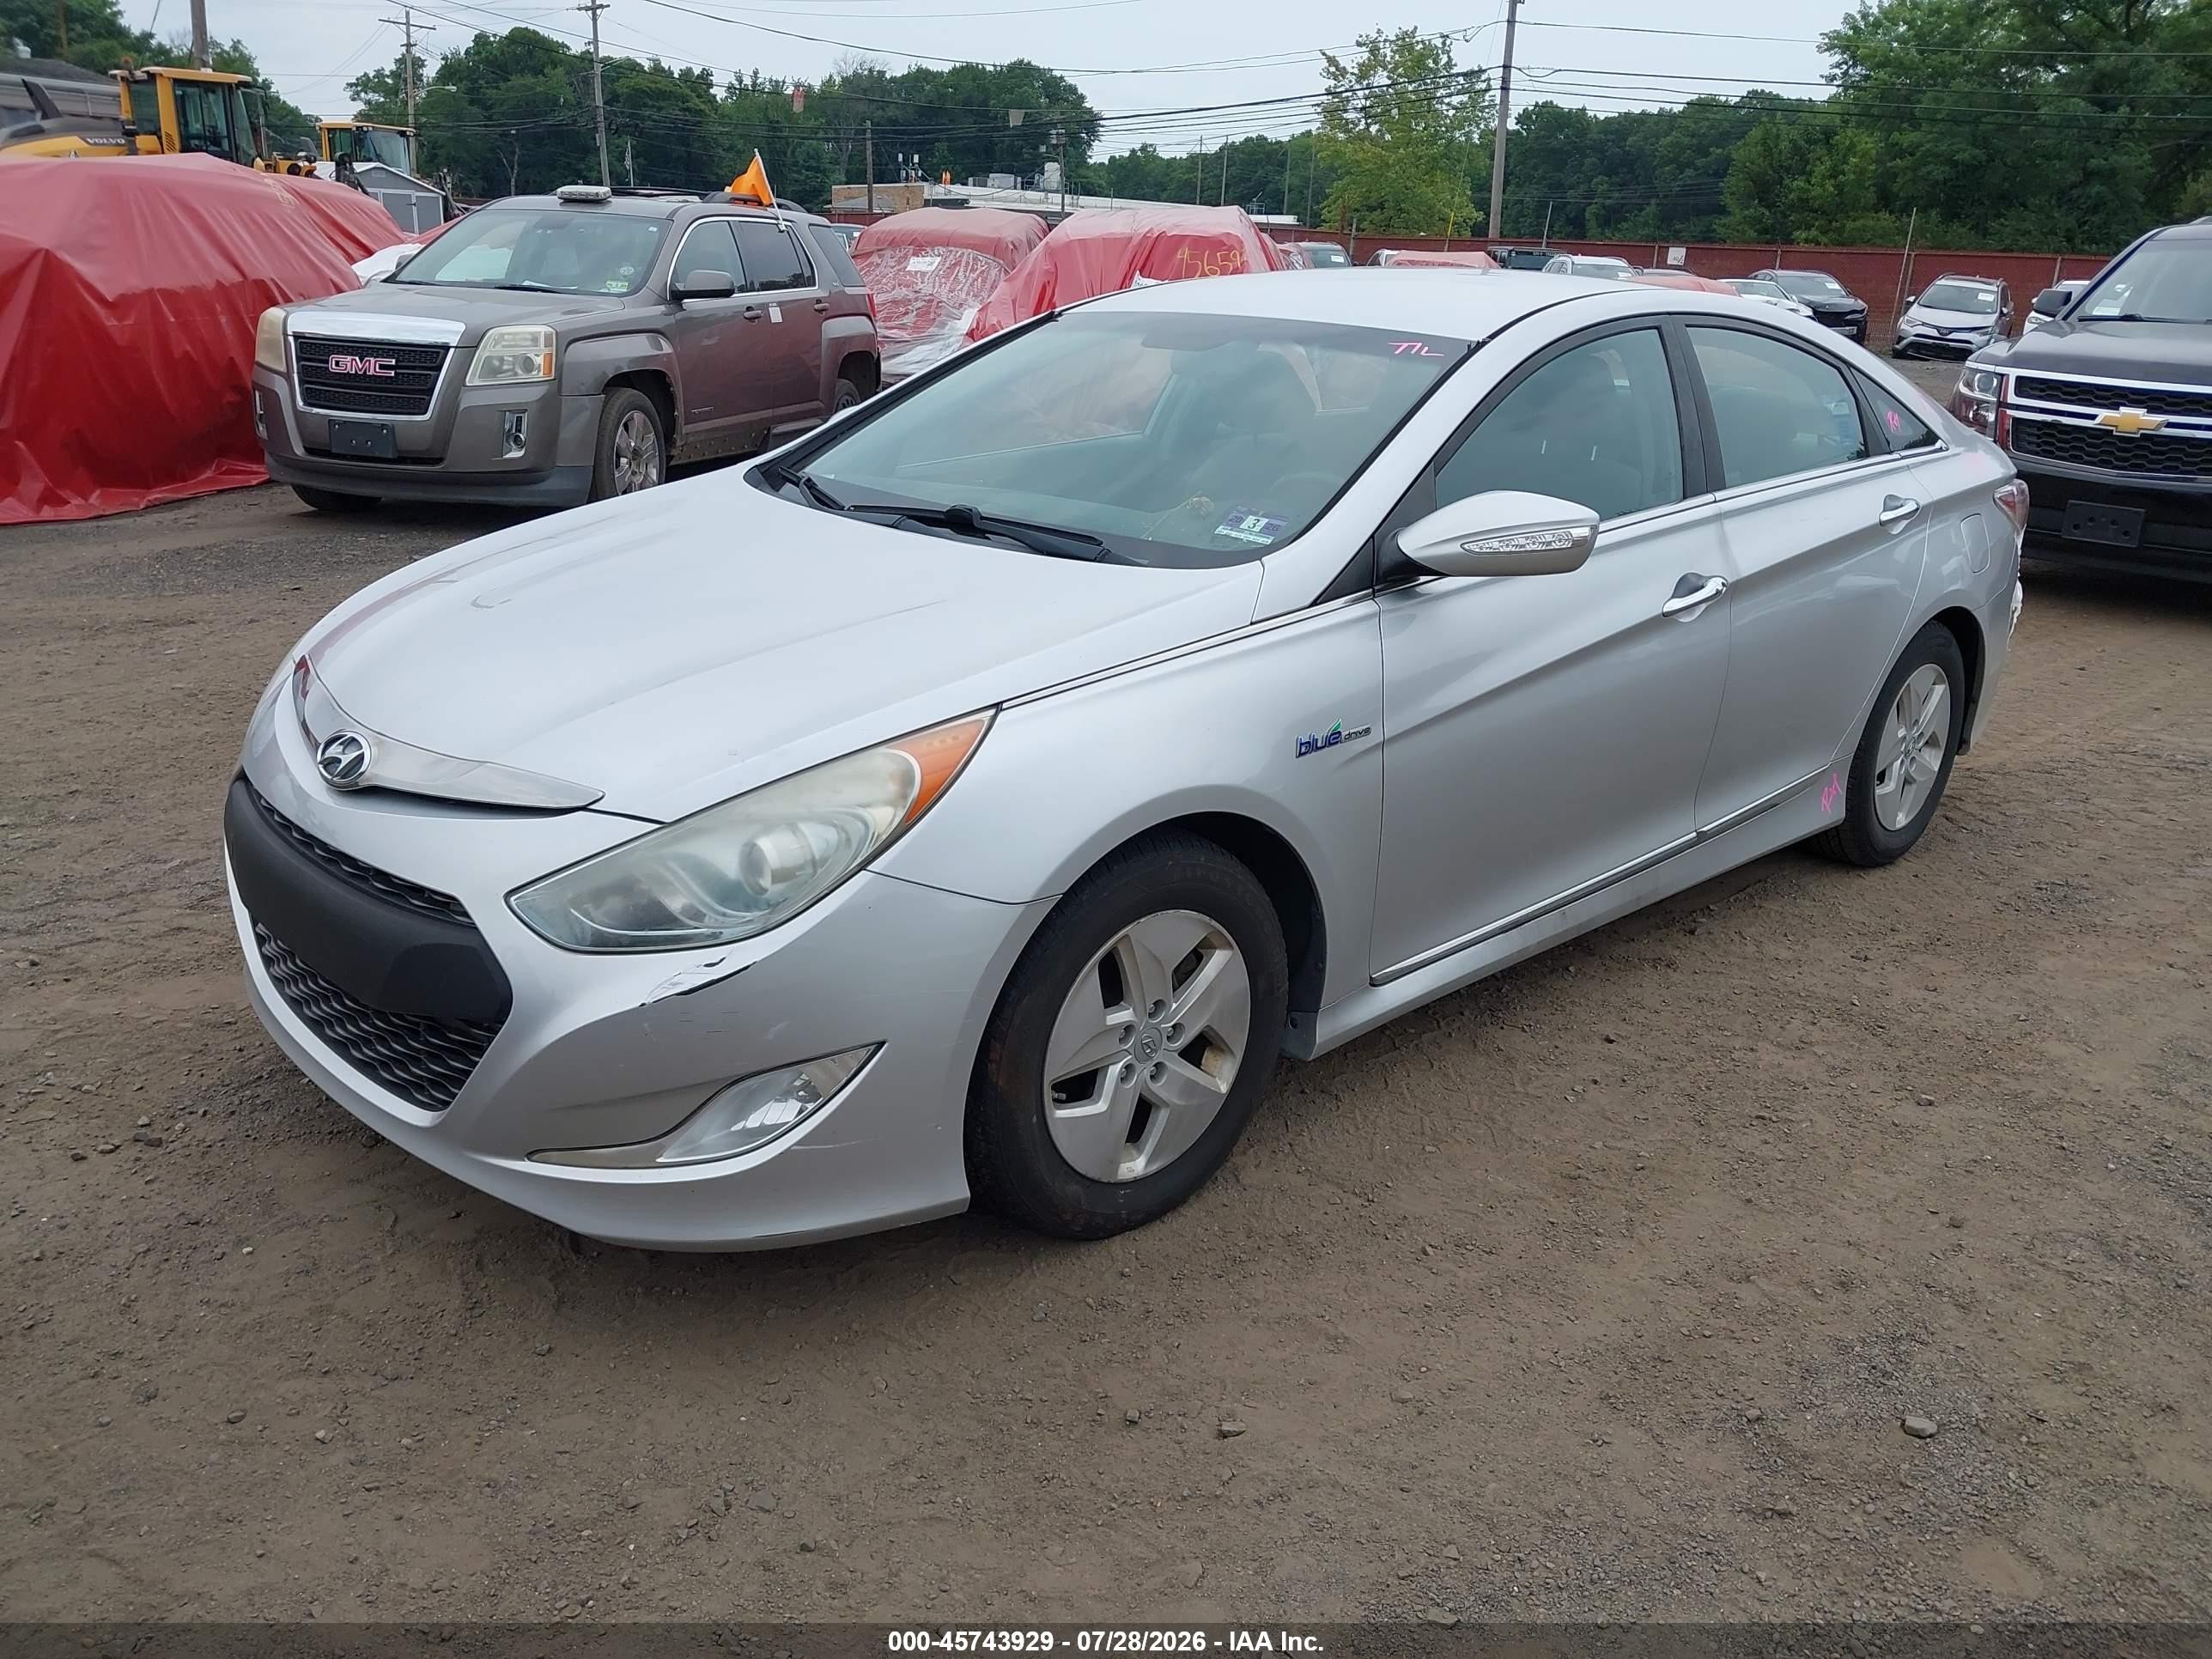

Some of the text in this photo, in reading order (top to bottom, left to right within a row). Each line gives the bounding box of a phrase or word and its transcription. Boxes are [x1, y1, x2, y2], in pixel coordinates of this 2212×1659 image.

[329, 355, 396, 376] GMC
[1228, 514, 1244, 524] 20
[1247, 518, 1261, 529] 3
[1295, 726, 1371, 758] blue drive
